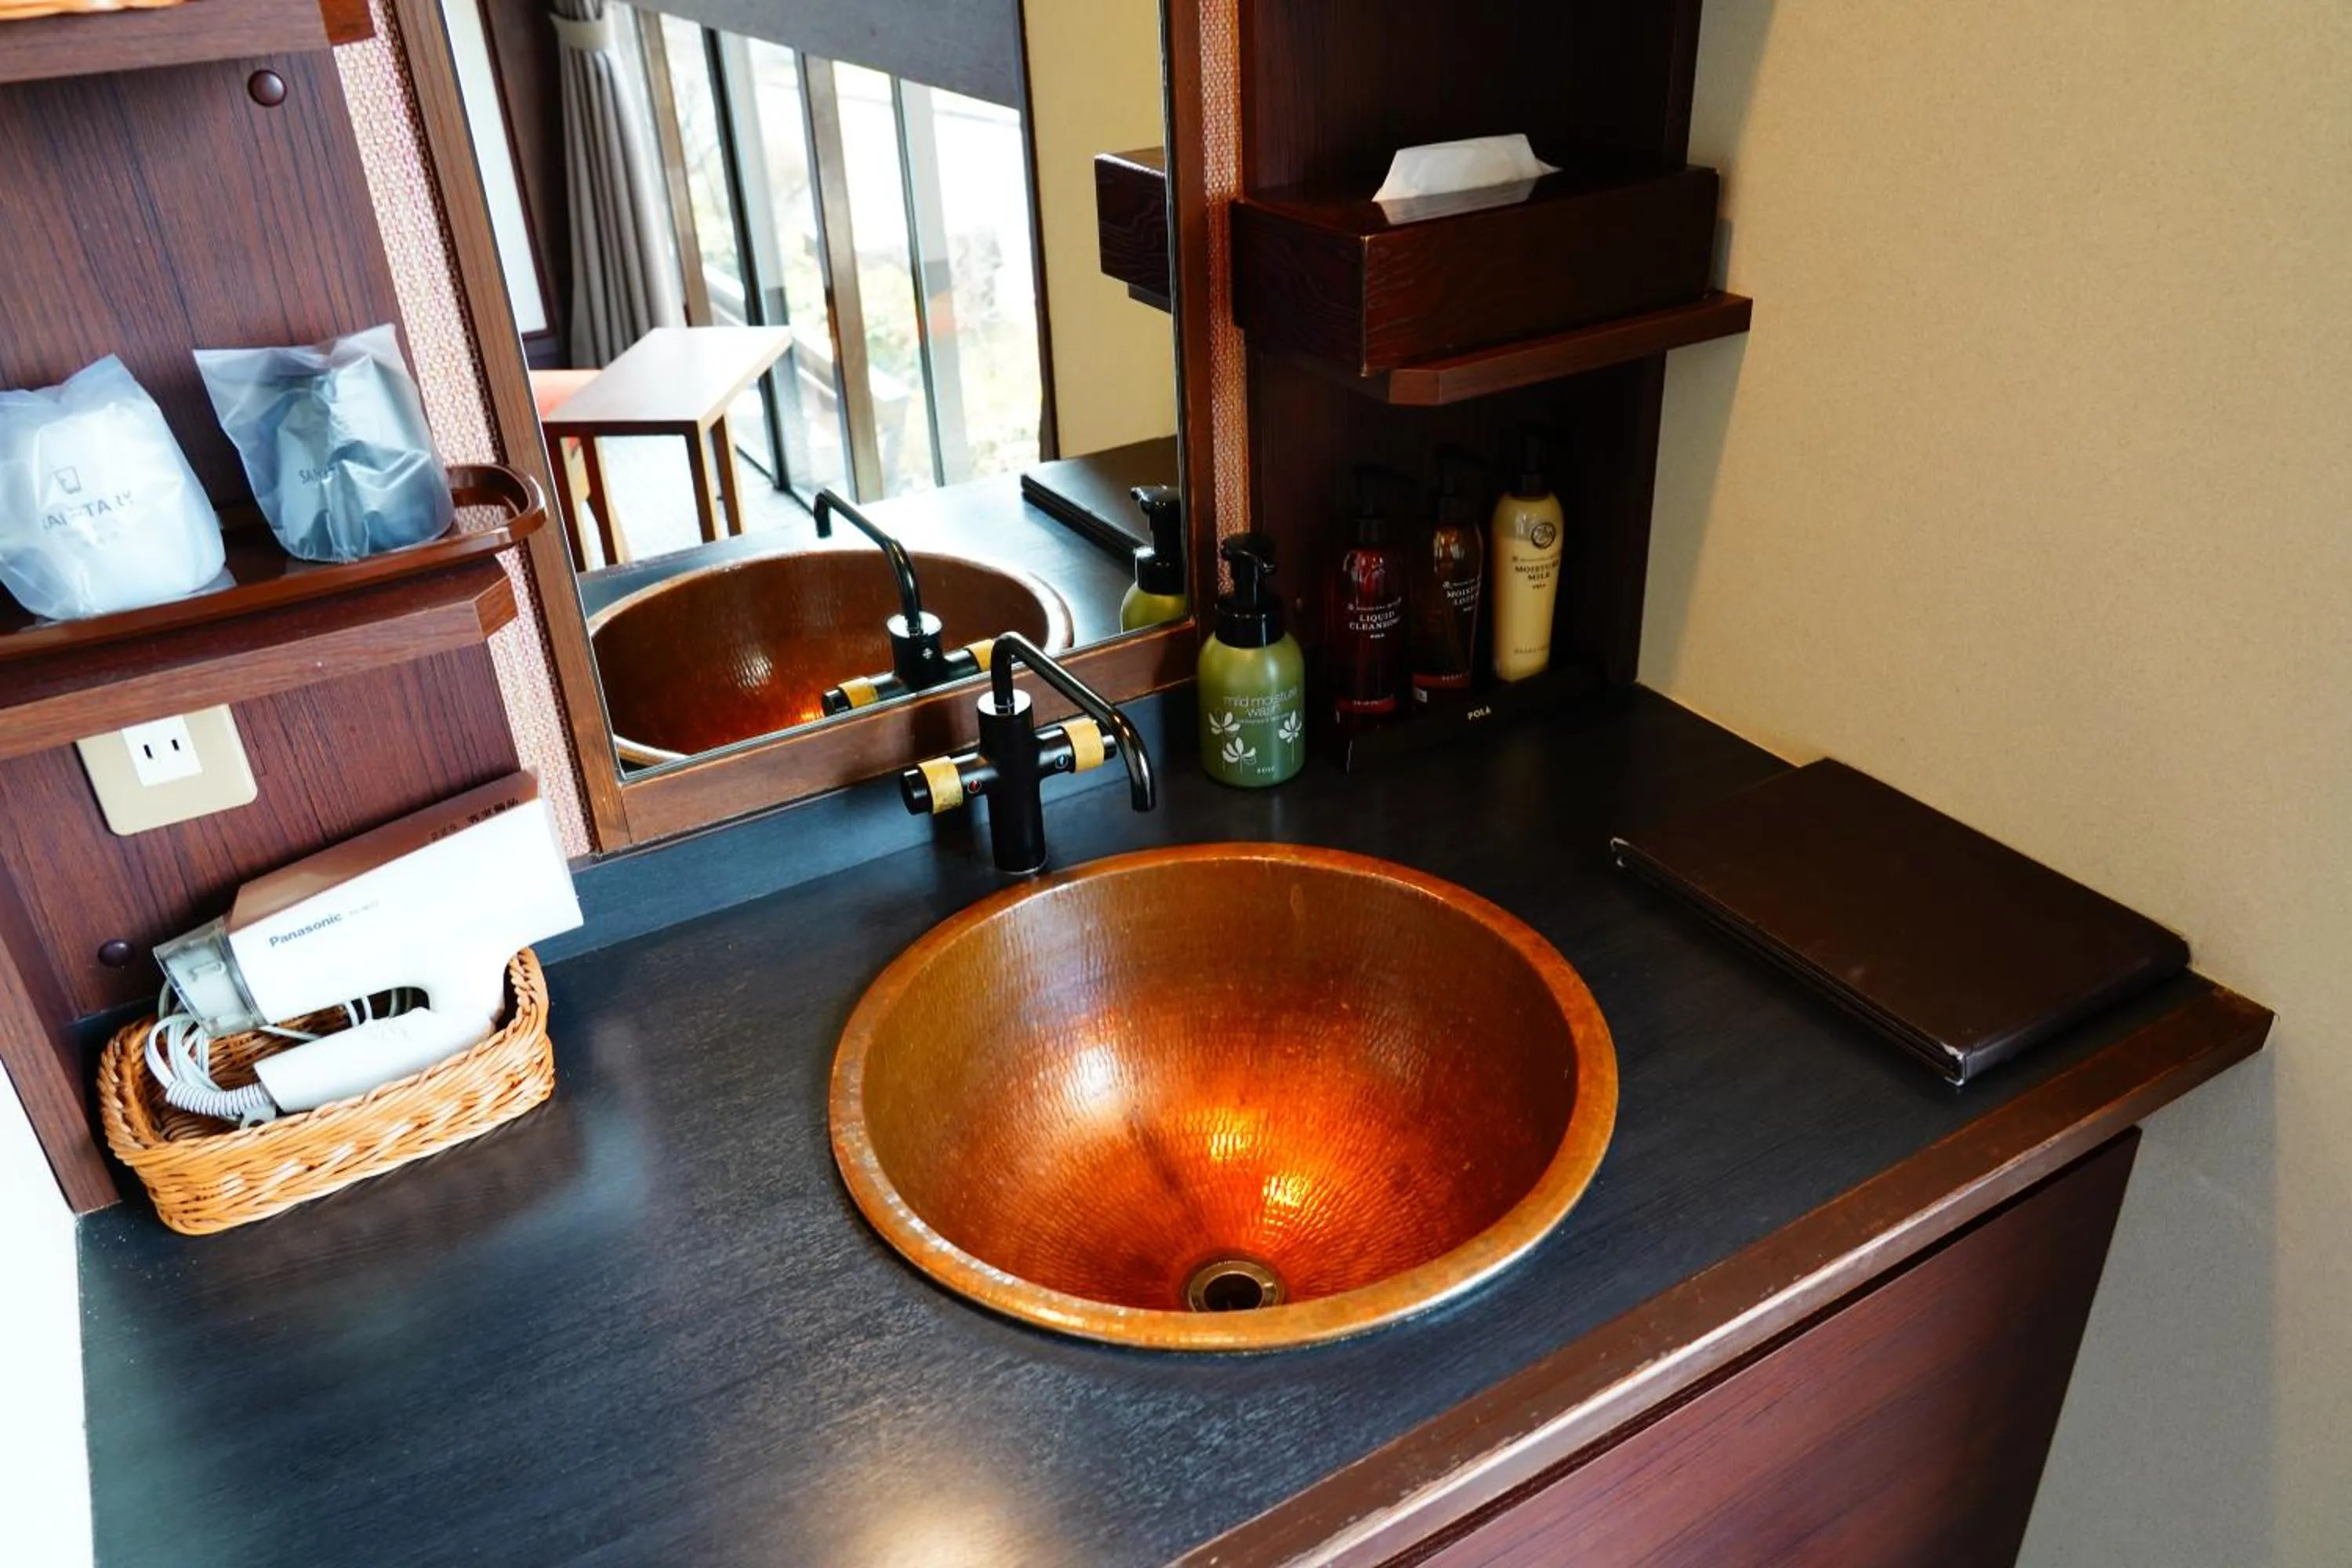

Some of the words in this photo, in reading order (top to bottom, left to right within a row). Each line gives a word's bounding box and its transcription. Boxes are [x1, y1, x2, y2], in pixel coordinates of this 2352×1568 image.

[1359, 610, 1395, 622] LIQUID
[1467, 706, 1491, 721] POLA
[269, 913, 343, 948] Panasonic
